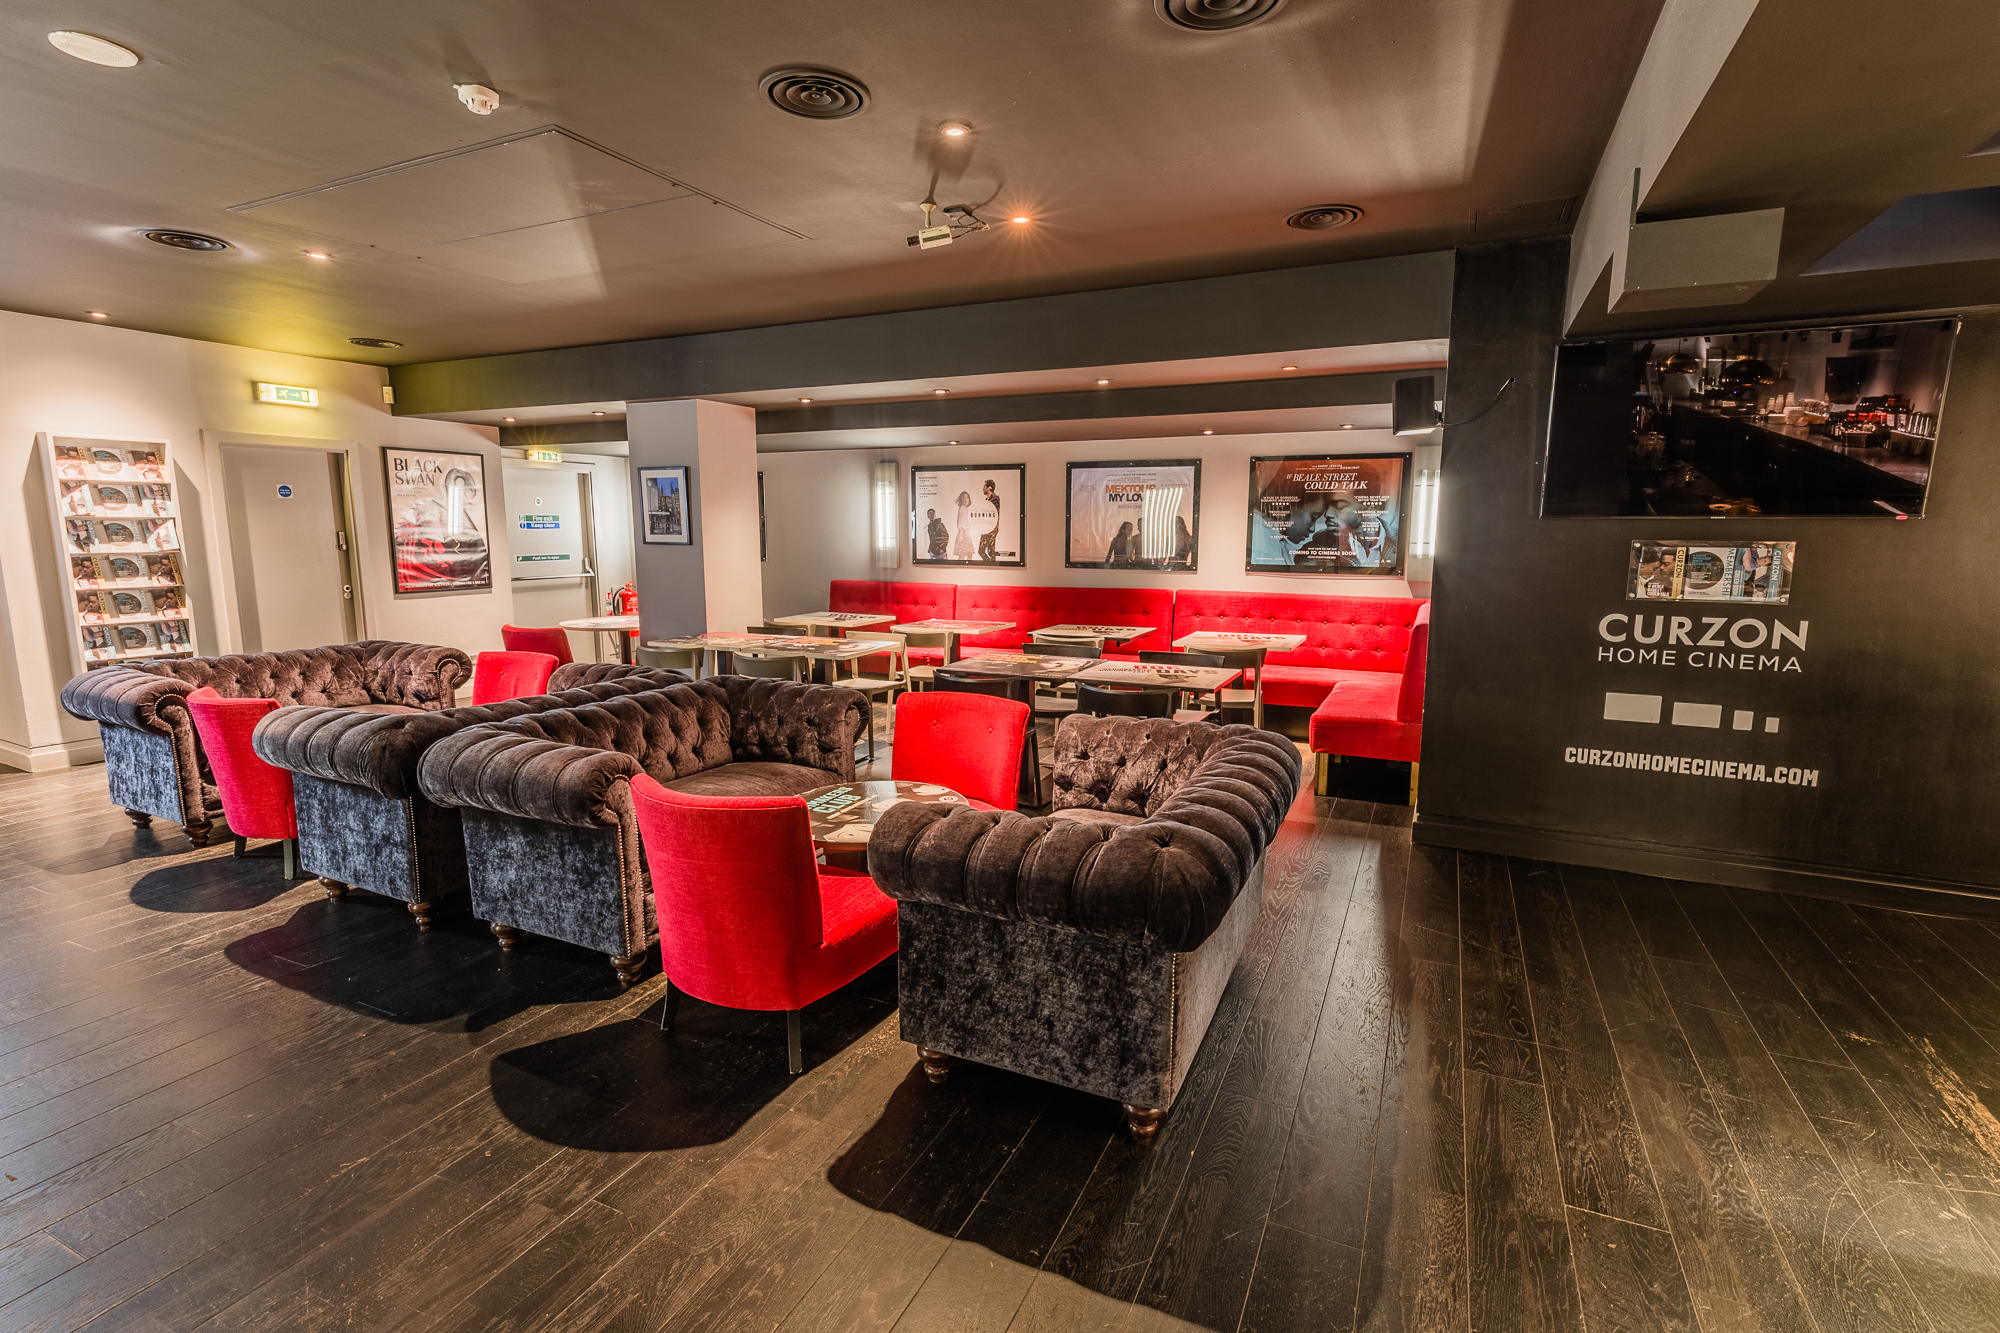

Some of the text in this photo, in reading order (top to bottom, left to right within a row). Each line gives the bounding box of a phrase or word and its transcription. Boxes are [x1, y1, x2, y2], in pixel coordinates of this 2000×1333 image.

[395, 472, 435, 486] SWAN
[1293, 473, 1321, 482] BEALE
[1323, 473, 1358, 481] STREET
[1304, 481, 1369, 490] COULD TALK
[1109, 494, 1125, 502] MY
[1675, 549, 1685, 578] CURZON
[1770, 550, 1782, 580] CURZON
[1598, 613, 1809, 652] CURZON
[1597, 646, 1803, 673] HOME CINEMA
[1564, 747, 1819, 787] CURZONHOMECINEMA.COM
[812, 794, 862, 814] CLUB
